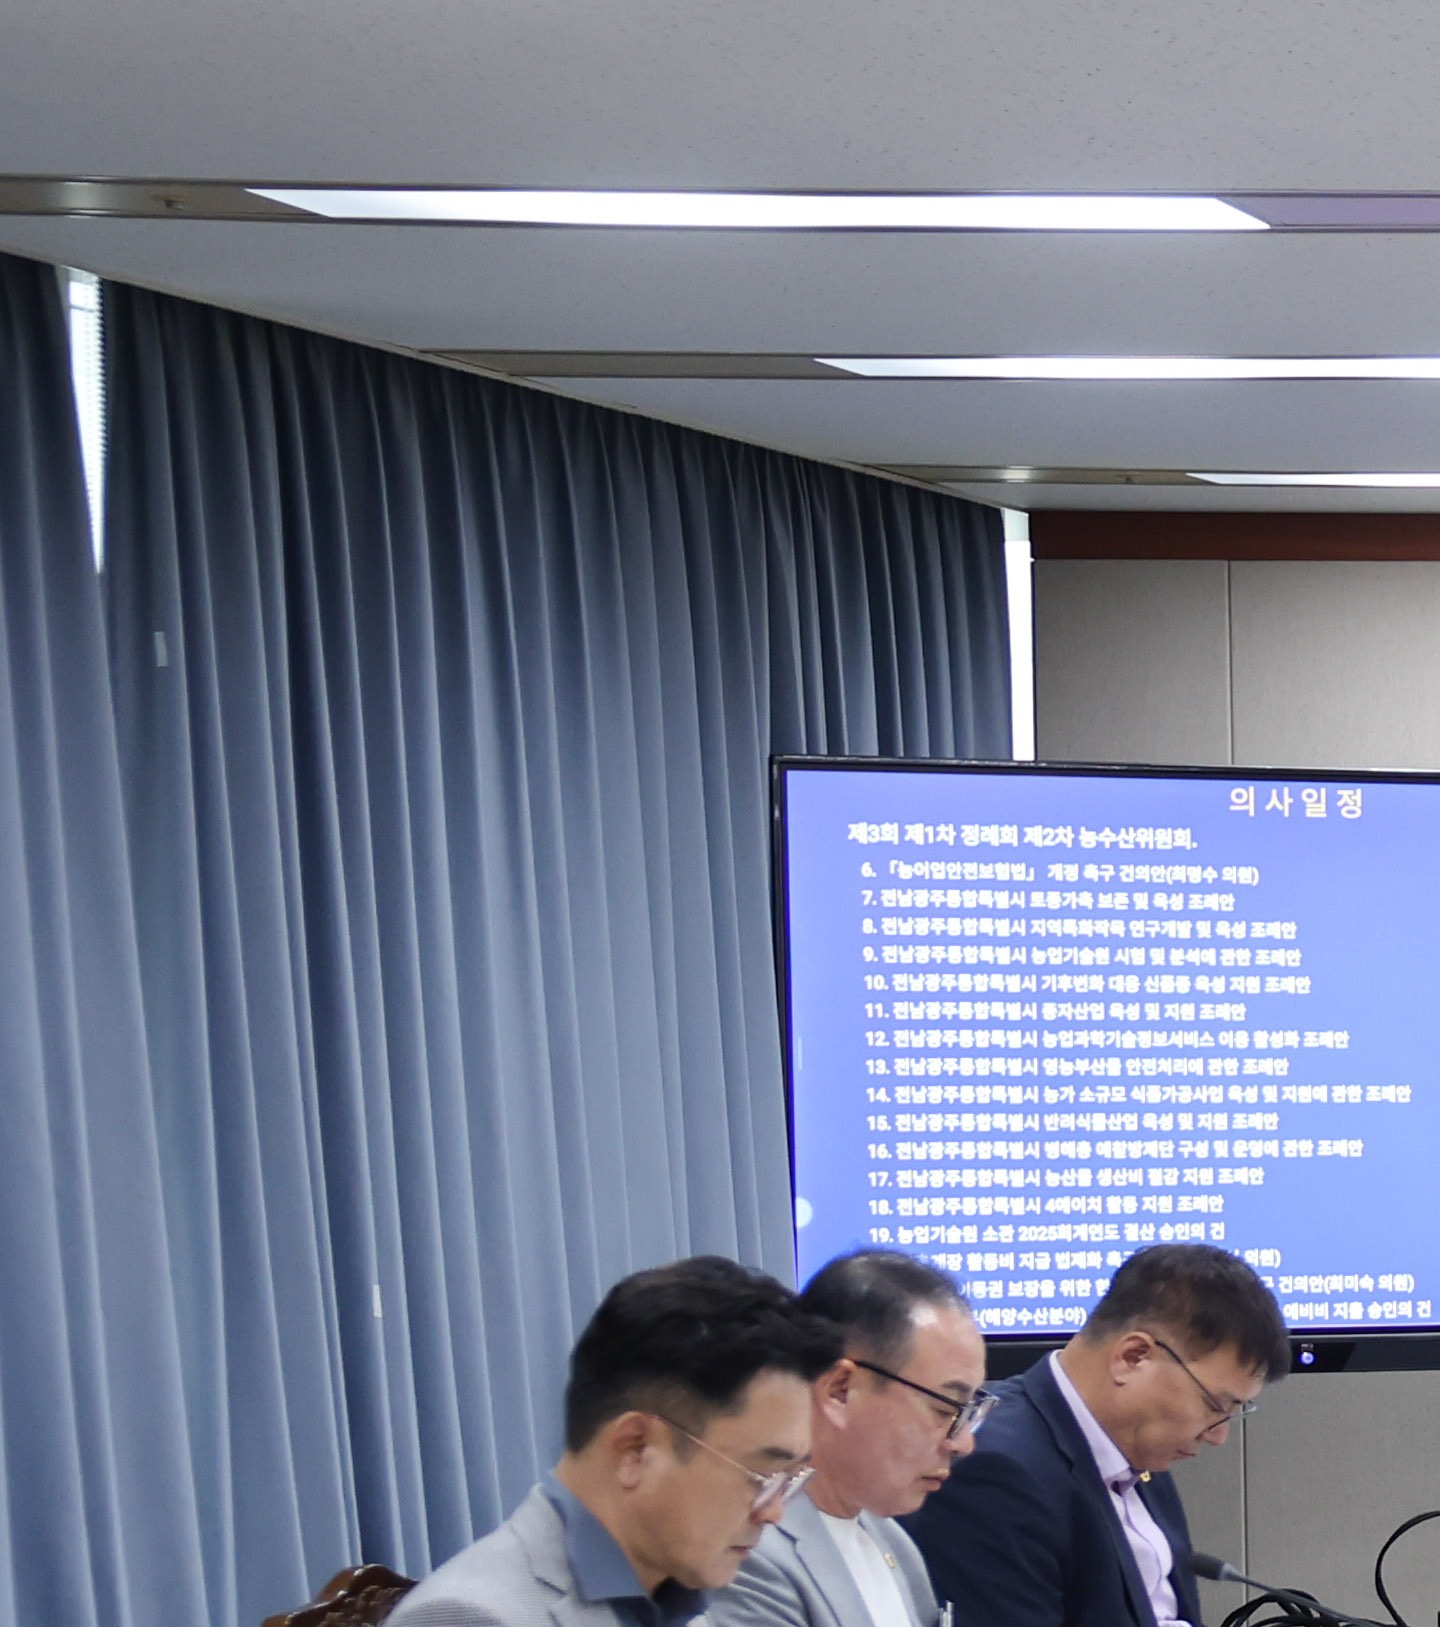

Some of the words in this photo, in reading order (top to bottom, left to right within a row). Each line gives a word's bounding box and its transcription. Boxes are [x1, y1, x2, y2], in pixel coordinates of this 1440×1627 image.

[847, 821, 899, 846] 제3회
[903, 822, 957, 847] 제1차
[960, 823, 1019, 848] 정례회
[1022, 824, 1075, 849] 제2차
[1078, 826, 1198, 851] 농수산위원회.
[860, 861, 877, 878] 6.
[1047, 862, 1079, 882] 개정
[1221, 865, 1260, 887] 의원)
[861, 889, 878, 906] 7.
[880, 888, 1026, 910] 전남광주통합특별시
[1096, 892, 1130, 911] 보존
[1132, 891, 1149, 911] 및
[1152, 892, 1185, 911] 육성
[1187, 892, 1236, 912] 조례안
[862, 917, 878, 934] 8.
[880, 916, 1027, 937] 전남광주통합특별시
[1128, 919, 1193, 939] 연구개발
[1195, 919, 1212, 939] 및
[1215, 920, 1247, 940] 육성
[1249, 920, 1298, 940] 조례안
[862, 945, 879, 963] 9.
[881, 944, 1027, 965] 전남광주통합특별시
[1030, 946, 1111, 966] 농업기술원
[1113, 946, 1146, 966] 시험
[1149, 947, 1166, 966] 및
[1219, 947, 1252, 967] 관한
[1254, 948, 1303, 967] 조례안
[863, 974, 889, 991] 10.
[892, 972, 1037, 993] 전남광주통합특별시
[1041, 973, 1106, 993] 기후변화
[1107, 974, 1141, 994] 대응
[1194, 975, 1226, 995] 육성
[1229, 975, 1261, 995] 지원
[1264, 975, 1312, 995] 조례안
[864, 1002, 890, 1019] 11.
[892, 1000, 1038, 1021] 전남광주통합특별시
[1041, 1001, 1106, 1021] 종자산업
[1108, 1002, 1141, 1022] 육성
[1144, 1002, 1161, 1021] 및
[1164, 1002, 1196, 1022] 지원
[1199, 1002, 1247, 1022] 조례안
[865, 1030, 890, 1047] 12.
[893, 1029, 1038, 1049] 전남광주통합특별시
[1217, 1029, 1250, 1049] 이용
[1303, 1030, 1350, 1049] 조례안
[865, 1058, 891, 1075] 13.
[893, 1057, 1039, 1077] 전남광주통합특별시
[1125, 1057, 1204, 1077] 안전처리에
[1207, 1057, 1240, 1077] 관한
[1242, 1057, 1290, 1077] 조례안
[866, 1087, 892, 1103] 14.
[894, 1084, 1040, 1105] 전남광주통합특별시
[1043, 1084, 1076, 1104] 농가
[1078, 1085, 1128, 1104] 소규모
[1129, 1084, 1224, 1104] 식품가공사업
[1227, 1084, 1259, 1104] 육성
[1262, 1084, 1279, 1104] 및
[1281, 1084, 1328, 1104] 지원에
[1331, 1084, 1364, 1104] 관한
[1365, 1084, 1412, 1104] 조례안
[866, 1115, 892, 1132] 15.
[895, 1112, 1040, 1133] 전남광주통합특별시
[1141, 1112, 1174, 1132] 육성
[1177, 1112, 1195, 1131] 및
[1196, 1111, 1229, 1132] 지원
[1231, 1111, 1280, 1131] 조례안
[867, 1143, 893, 1160] 16.
[895, 1140, 1041, 1161] 전남광주통합특별시
[1177, 1139, 1210, 1159] 구성
[1212, 1139, 1230, 1159] 및
[1282, 1138, 1315, 1158] 관한
[1316, 1138, 1364, 1158] 조례안
[867, 1171, 893, 1187] 17.
[895, 1168, 1041, 1189] 전남광주통합특별시
[1044, 1167, 1093, 1188] 농산물
[1095, 1167, 1144, 1187] 생산비
[1182, 1167, 1214, 1186] 지원
[1217, 1166, 1265, 1186] 조례안
[868, 1199, 894, 1216] 18.
[896, 1196, 1041, 1217] 전남광주통합특별시
[1141, 1194, 1174, 1214] 지원
[1176, 1194, 1225, 1214] 조례안
[869, 1227, 895, 1244] 19.
[896, 1224, 979, 1245] 농업기술원
[981, 1223, 1015, 1244] 소관
[1017, 1222, 1121, 1243] 2025회계연도
[1209, 1221, 1225, 1241] 건
[966, 1251, 1015, 1272] 활동비
[1018, 1251, 1052, 1271] 지급
[1054, 1250, 1103, 1270] 법제화
[1243, 1248, 1282, 1269] 의원)
[1007, 1279, 1057, 1299] 보장을
[1059, 1278, 1093, 1298] 위한
[1377, 1273, 1415, 1294] 의원)
[974, 1306, 1087, 1329] (해양수산분야)
[1282, 1301, 1330, 1321] 예비비
[1416, 1299, 1432, 1319] 건
